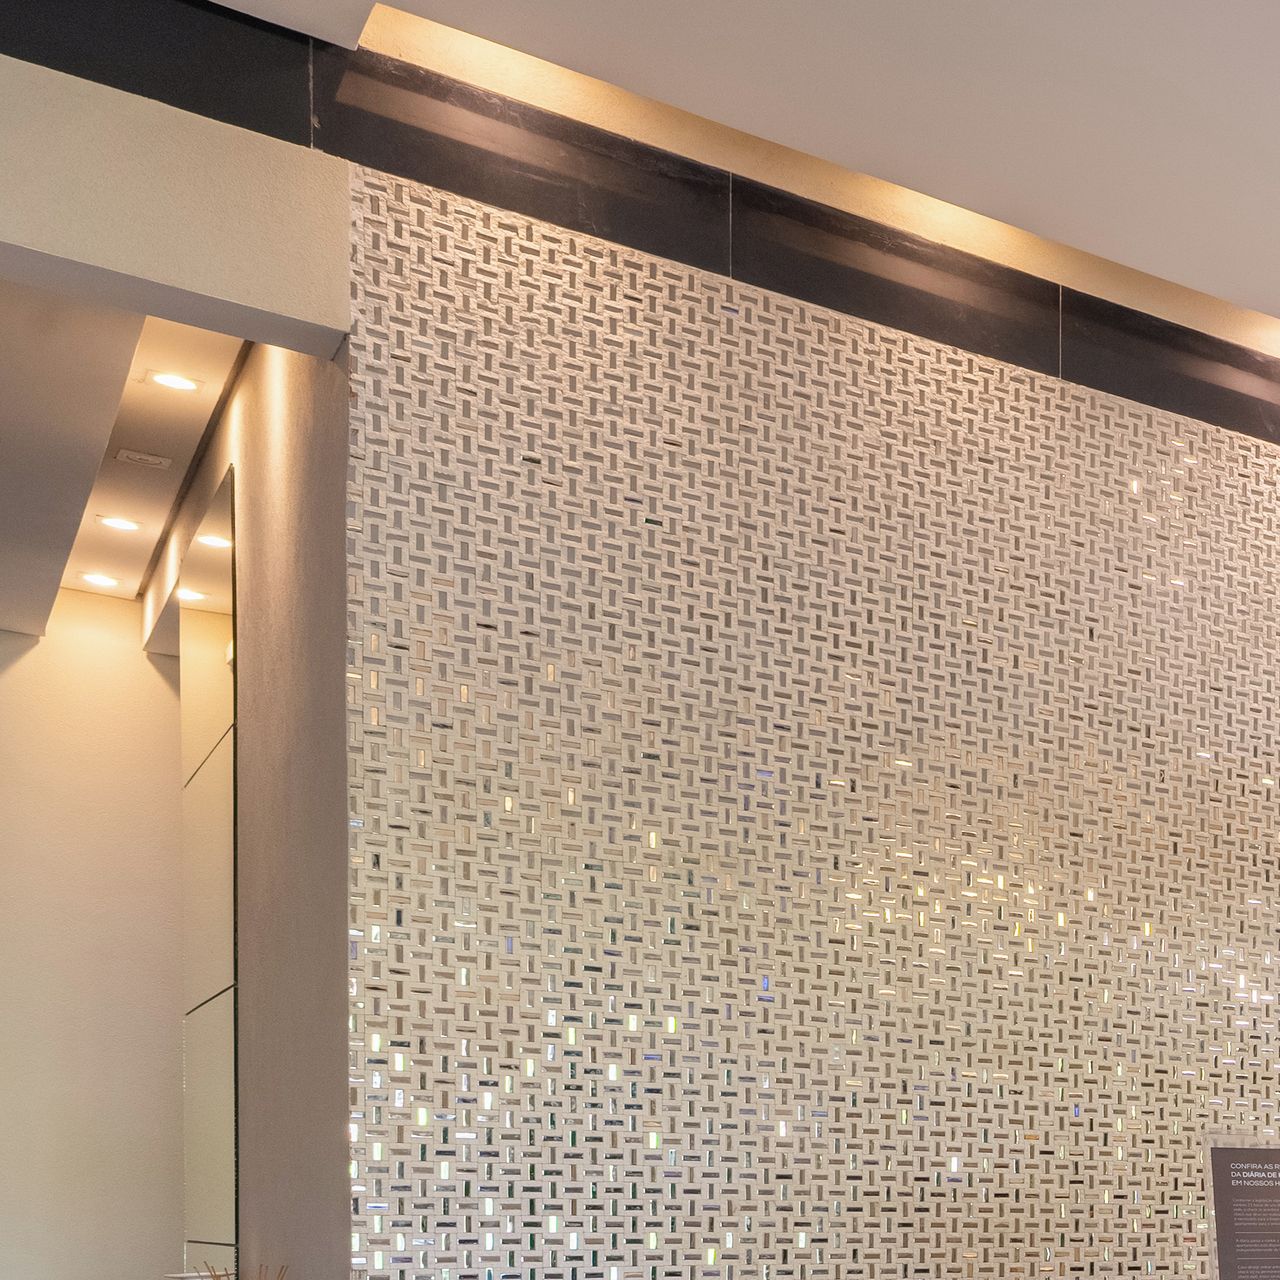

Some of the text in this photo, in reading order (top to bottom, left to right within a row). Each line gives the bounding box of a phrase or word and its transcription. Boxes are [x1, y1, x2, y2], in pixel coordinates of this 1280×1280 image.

[1230, 1162, 1262, 1170] CONFIRA
[1242, 1170, 1267, 1178] DIÁRIA
[1267, 1171, 1277, 1179] DE
